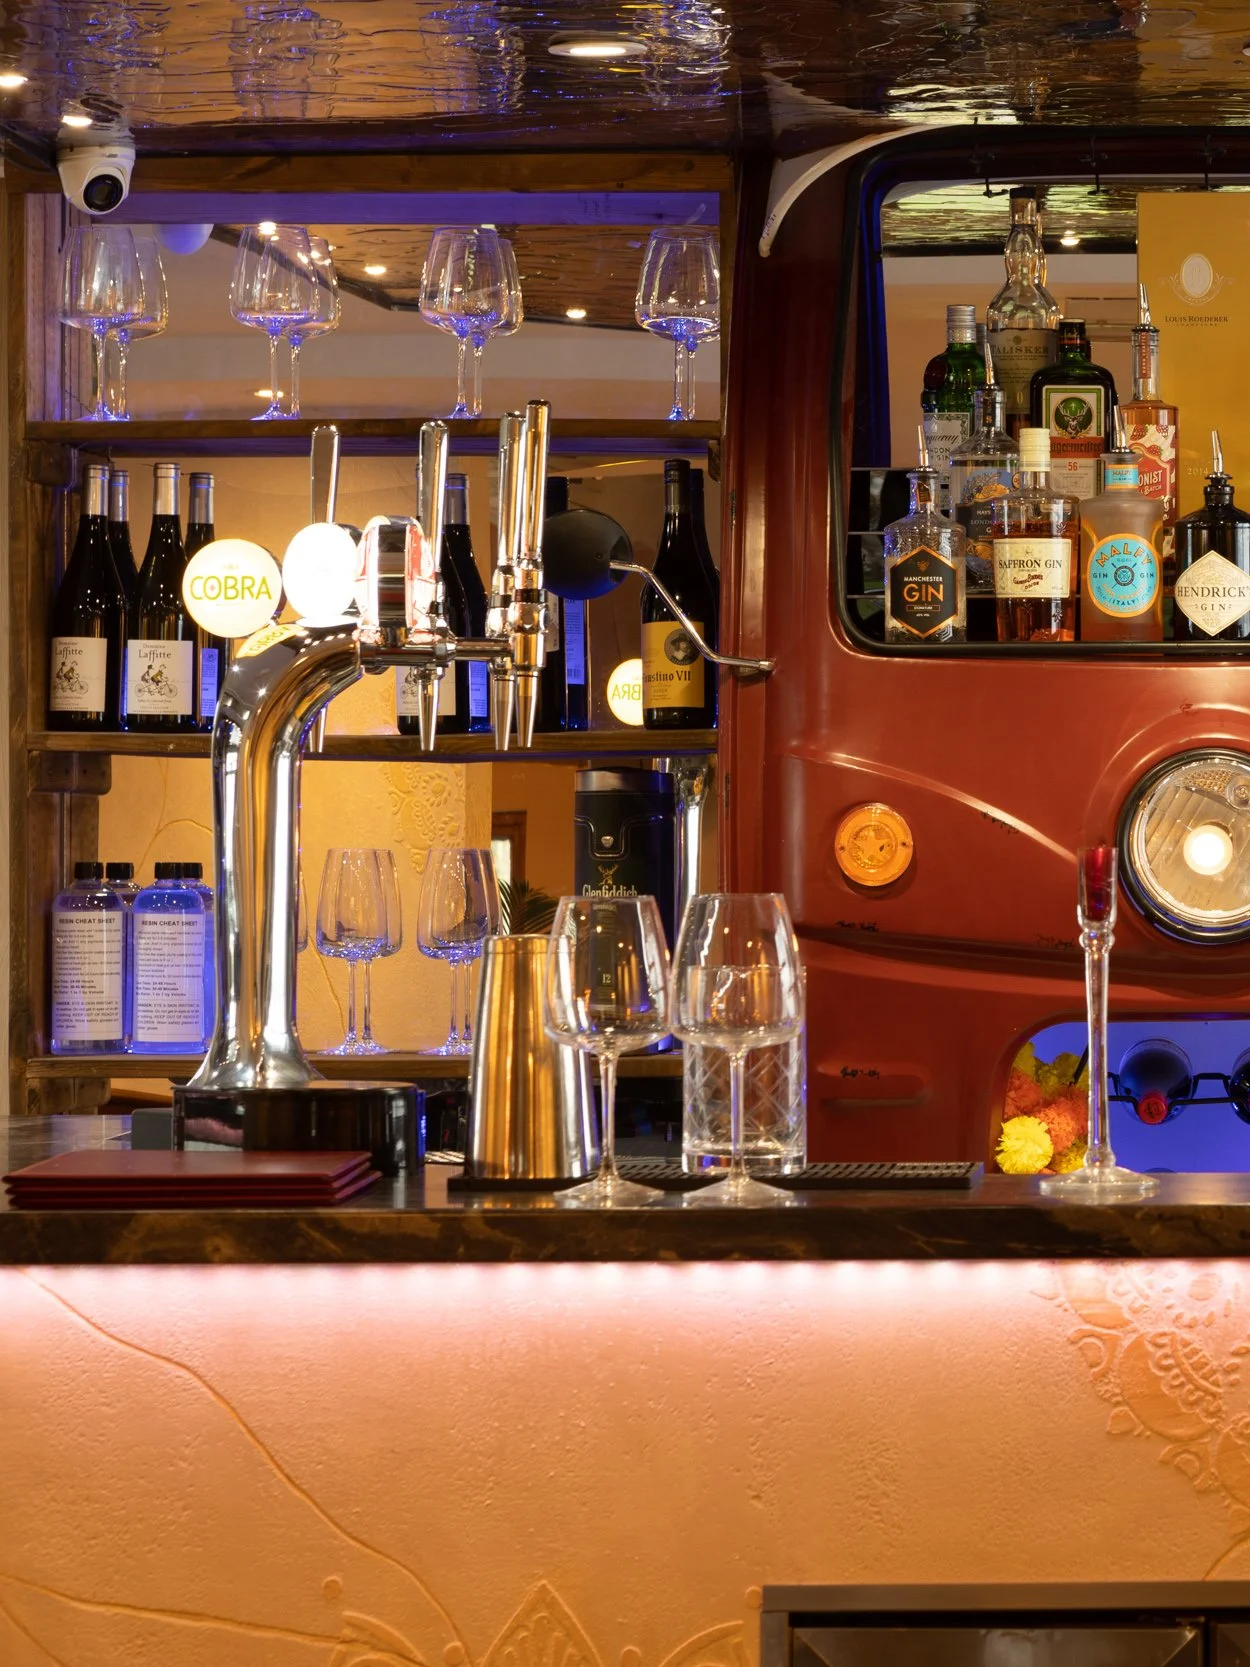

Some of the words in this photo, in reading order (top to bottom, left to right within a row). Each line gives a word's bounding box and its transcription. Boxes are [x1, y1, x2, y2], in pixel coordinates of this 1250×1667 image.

[1165, 315, 1187, 323] LOUIS
[1188, 315, 1228, 323] ROEDERER
[990, 345, 1050, 354] TALISKER
[924, 434, 959, 444] queray
[1067, 461, 1078, 471] 56
[1138, 470, 1162, 485] ONIST
[1095, 543, 1153, 568] MALFY
[998, 559, 1041, 569] SAFFRON
[1044, 559, 1062, 569] GIN
[190, 575, 272, 600] COBRA
[903, 584, 944, 602] GIN
[1200, 603, 1226, 611] GIN
[55, 647, 84, 659] Laffitte
[138, 649, 172, 662] Laffitte
[675, 671, 691, 681] VII
[582, 884, 638, 897] Glenfiddich
[602, 973, 611, 983] 12
